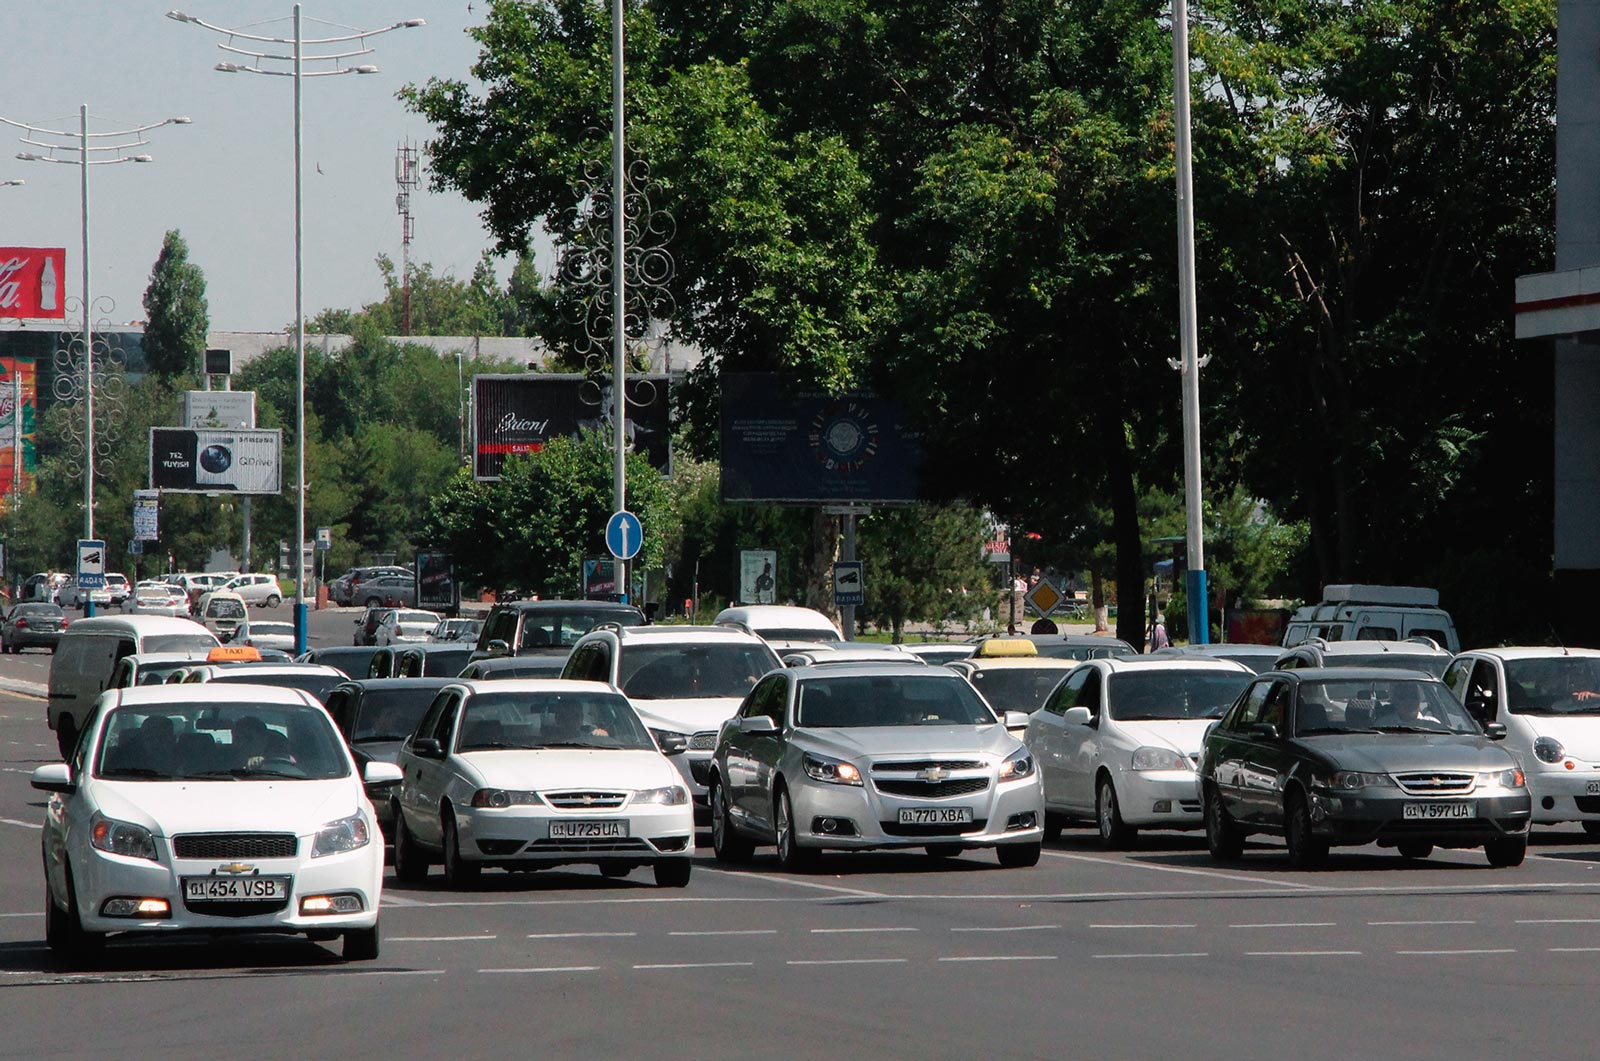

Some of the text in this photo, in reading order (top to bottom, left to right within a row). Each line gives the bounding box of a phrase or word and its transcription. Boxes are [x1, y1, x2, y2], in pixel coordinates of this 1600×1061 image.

[79, 576, 103, 585] RADAR
[902, 809, 964, 822] 01 770 XBA
[1406, 806, 1417, 816] 01
[553, 824, 564, 835] 01
[190, 880, 275, 897] 01 454 VSB
